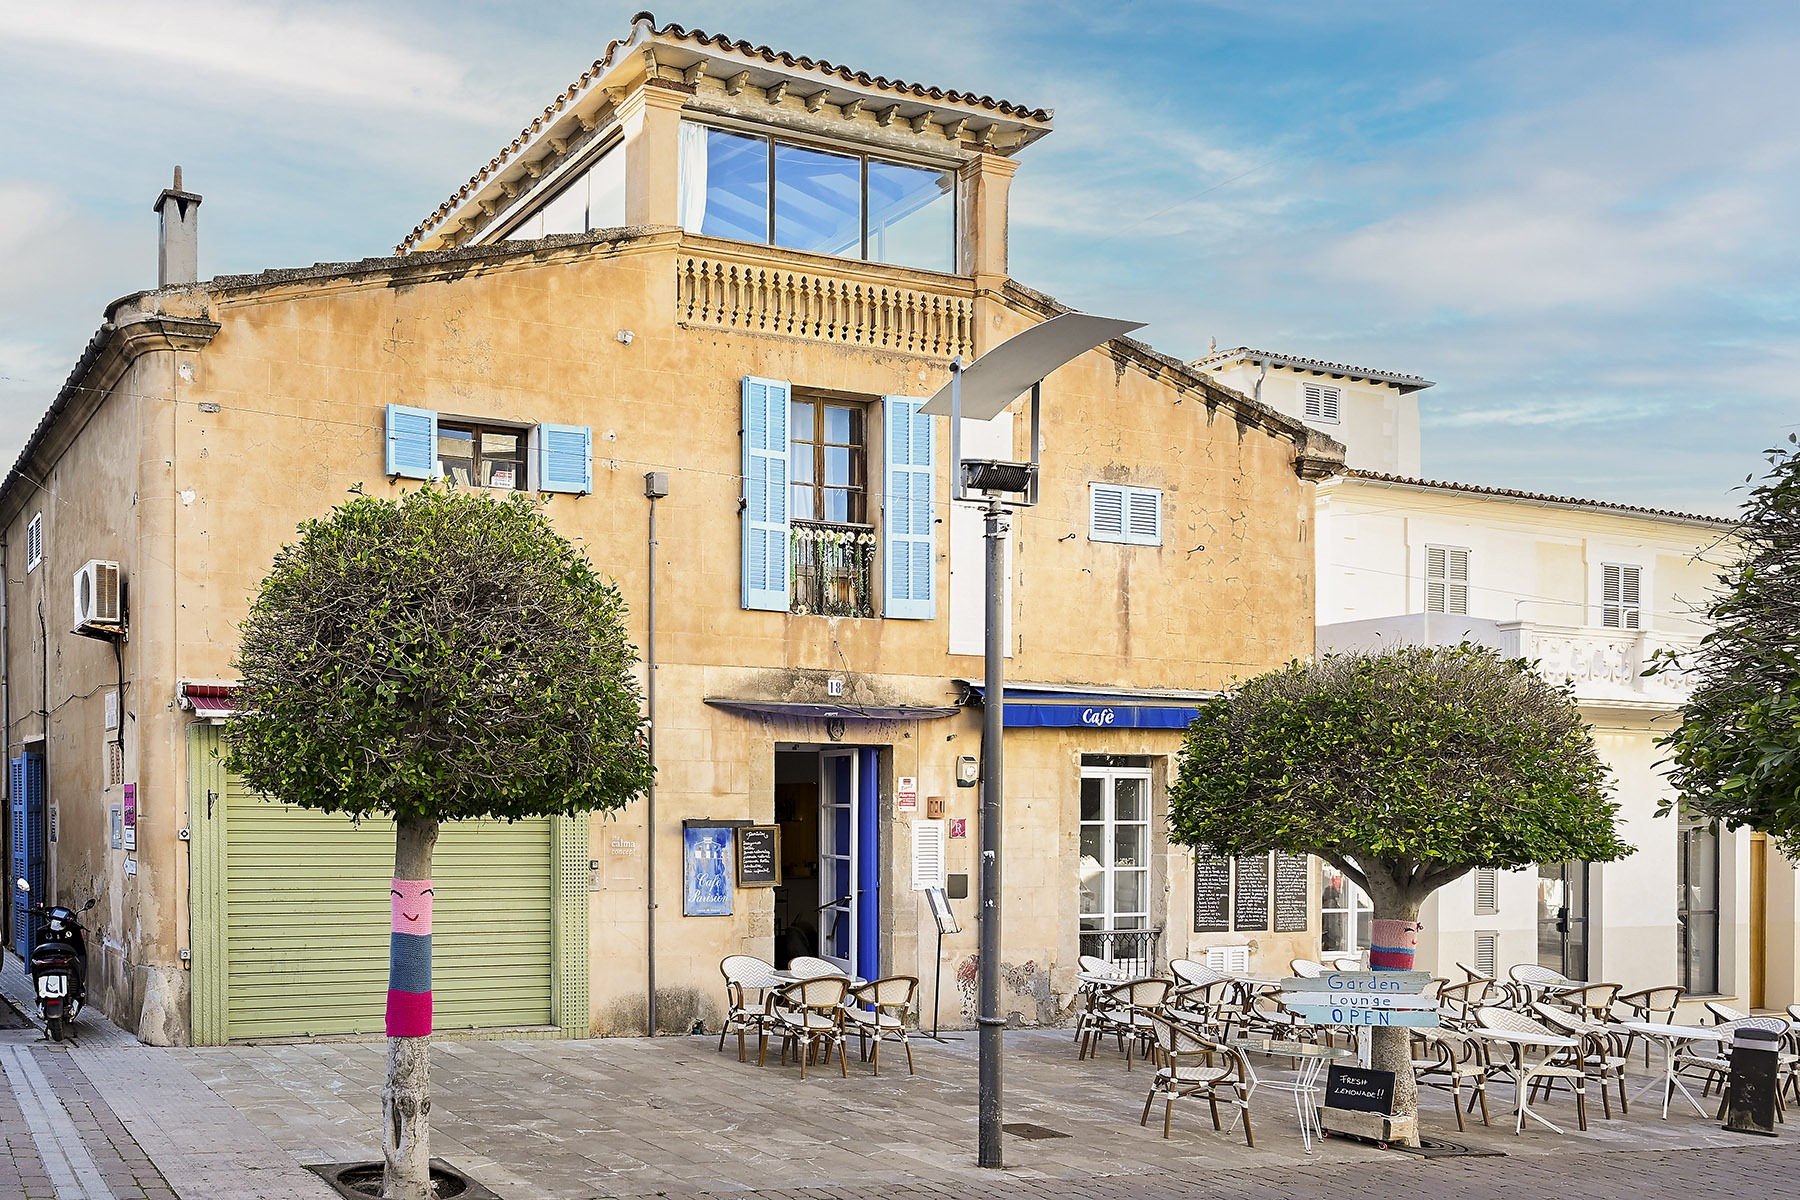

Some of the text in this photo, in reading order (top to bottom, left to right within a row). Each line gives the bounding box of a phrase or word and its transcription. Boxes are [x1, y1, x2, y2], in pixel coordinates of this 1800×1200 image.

[830, 681, 842, 694] 18
[1082, 708, 1115, 727] Cafè
[611, 838, 636, 848] calma
[1327, 974, 1400, 991] Garden
[1329, 994, 1391, 1007] Lounge
[1332, 1008, 1390, 1025] OPEN
[1339, 1074, 1368, 1086] FRESH
